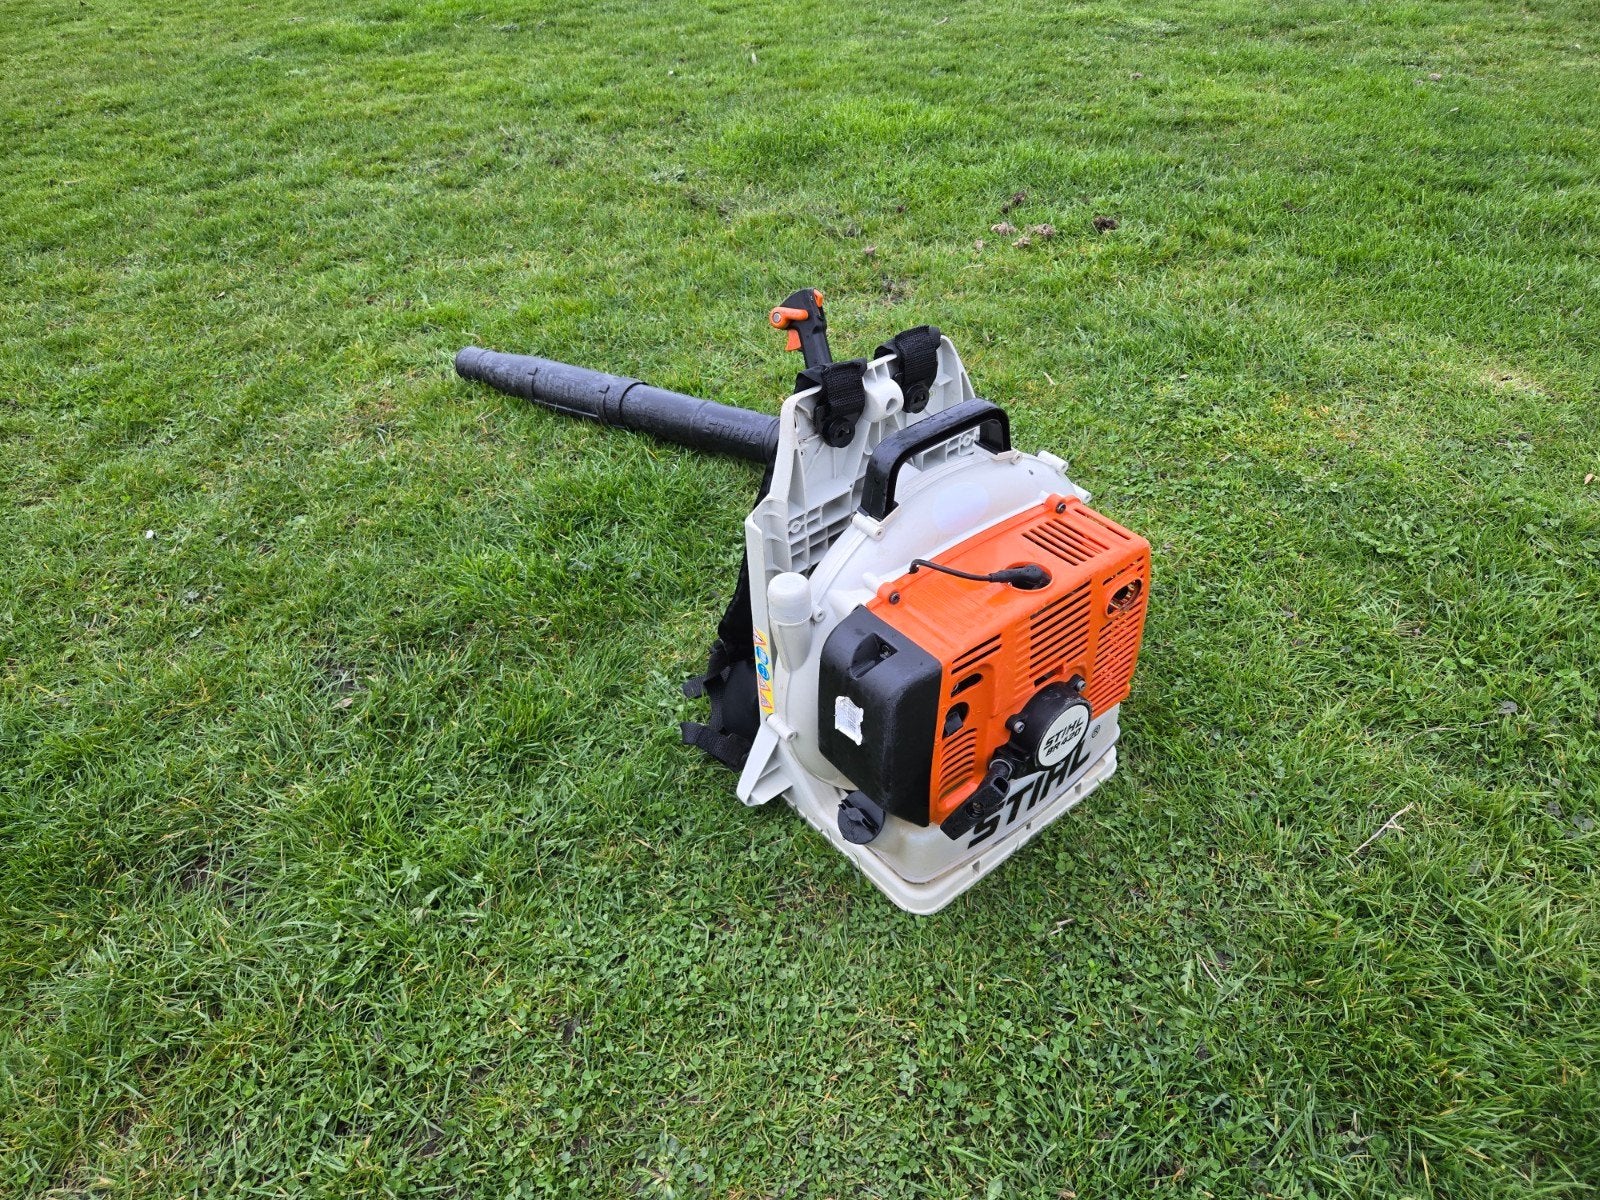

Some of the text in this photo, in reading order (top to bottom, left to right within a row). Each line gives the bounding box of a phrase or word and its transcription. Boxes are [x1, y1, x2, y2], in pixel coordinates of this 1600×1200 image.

[1043, 716, 1084, 750] STIHL
[1045, 726, 1082, 757] BR 420
[967, 738, 1091, 849] STIHL
